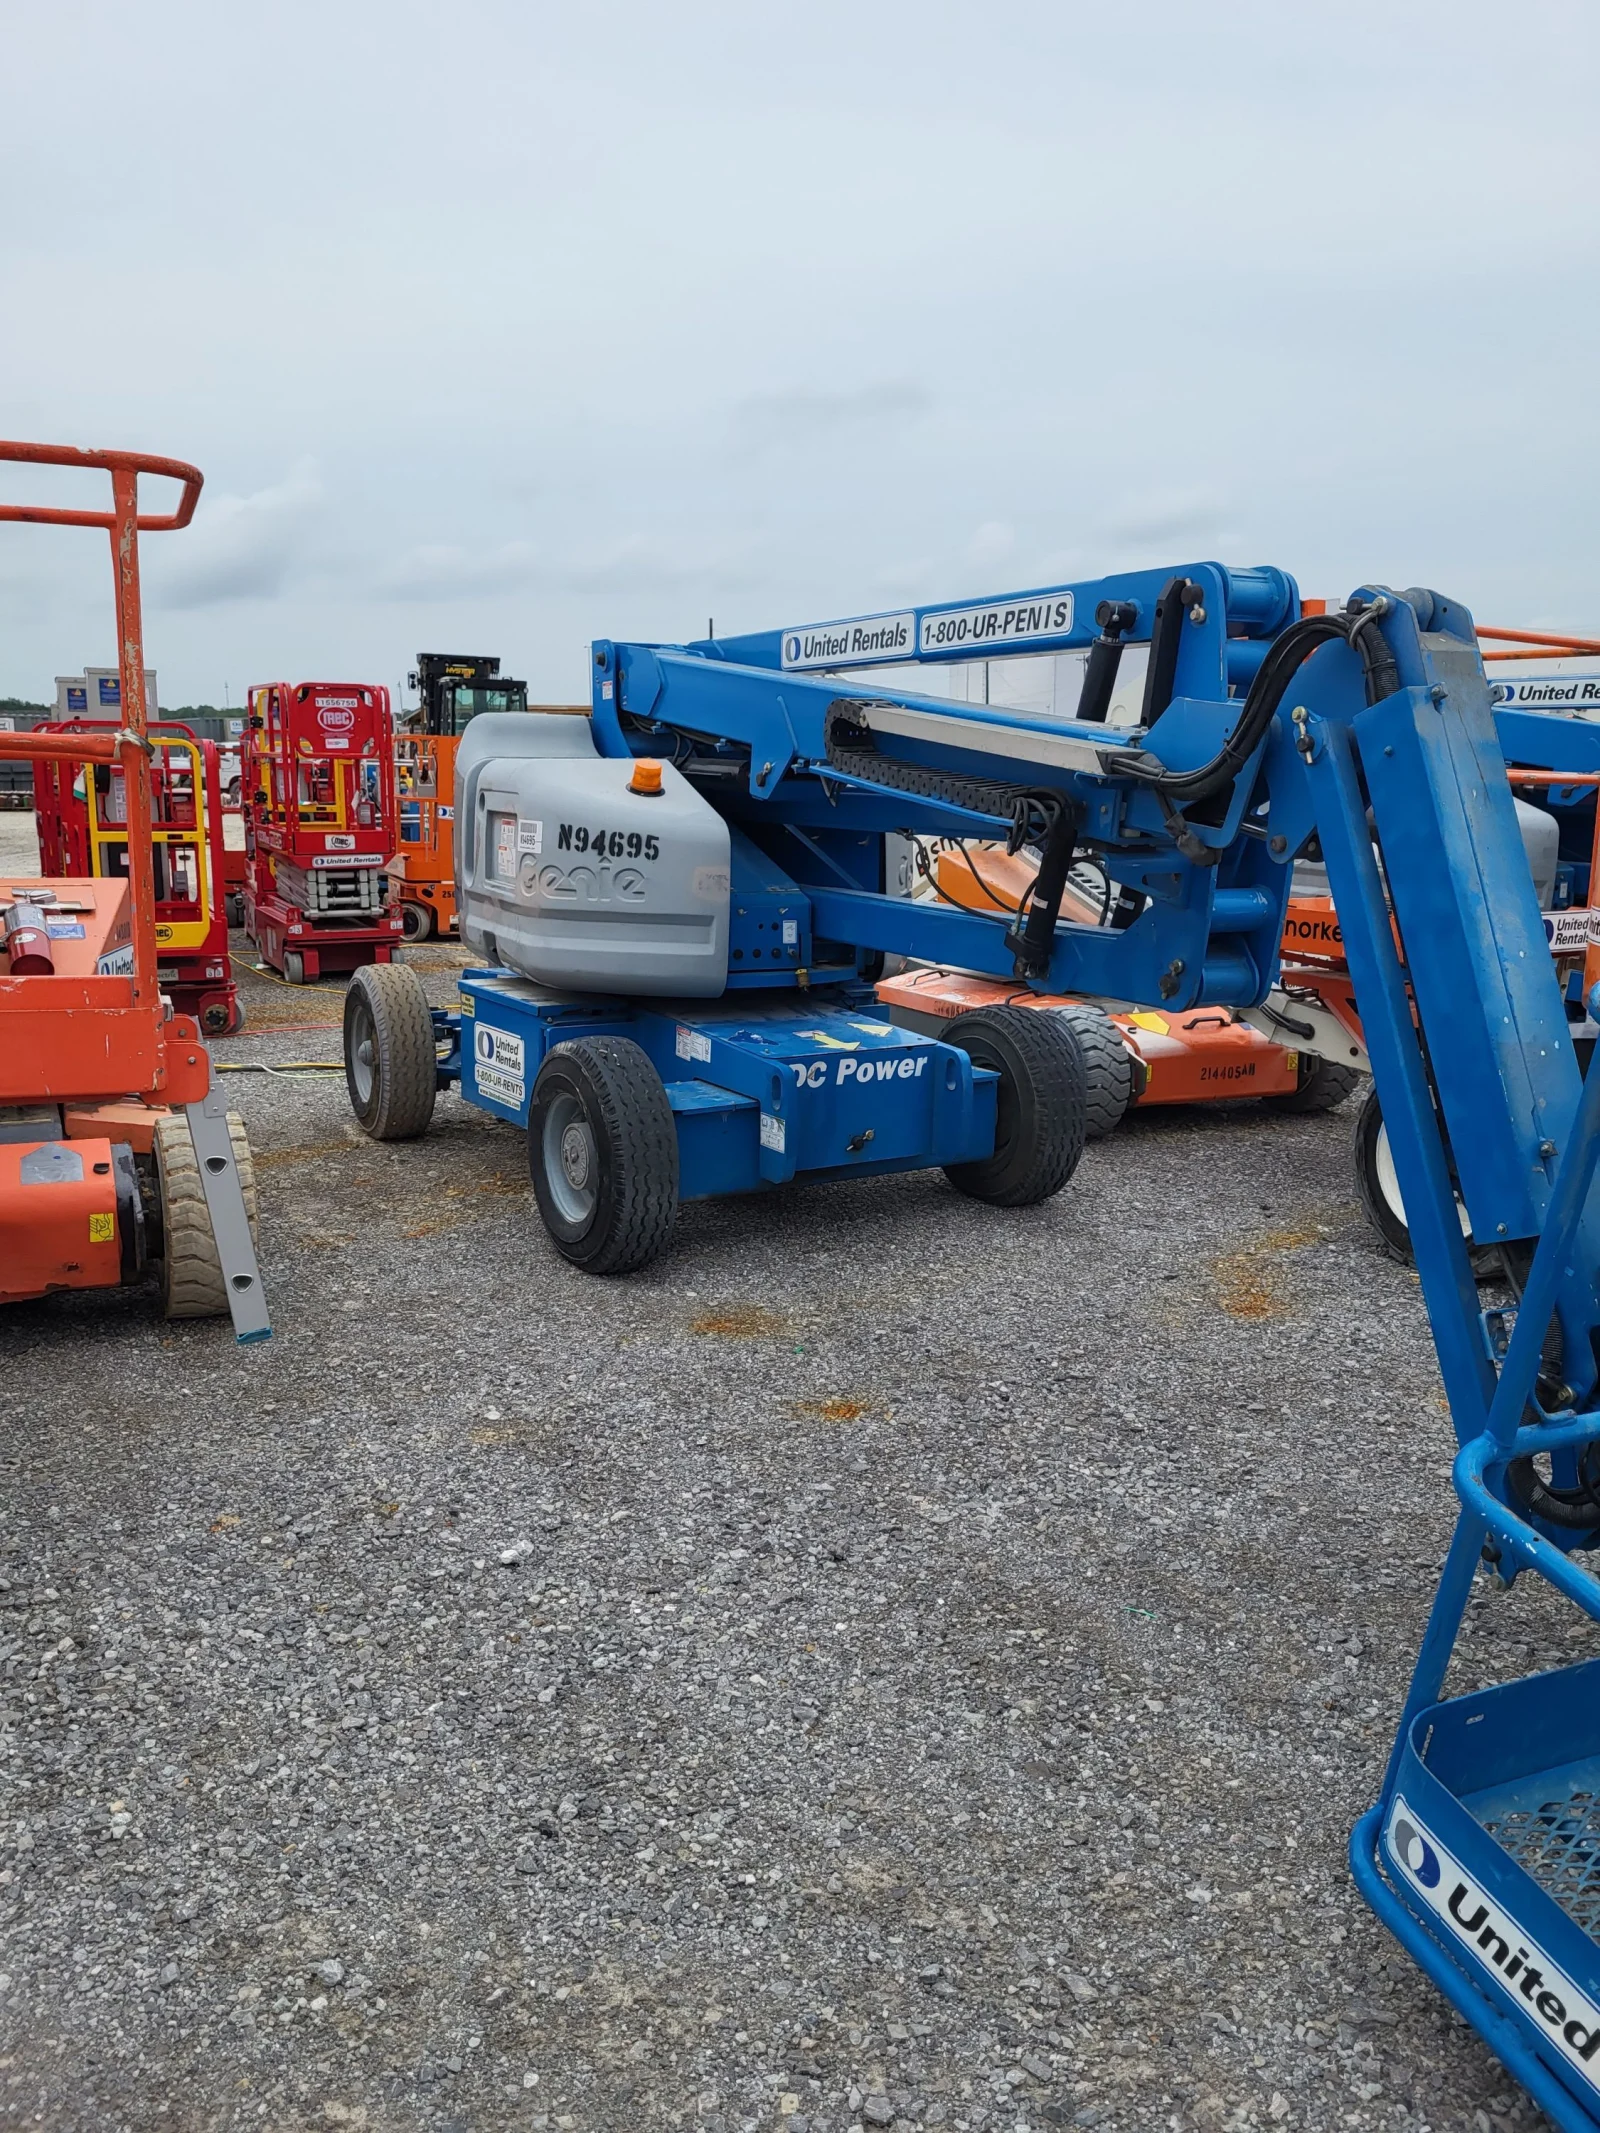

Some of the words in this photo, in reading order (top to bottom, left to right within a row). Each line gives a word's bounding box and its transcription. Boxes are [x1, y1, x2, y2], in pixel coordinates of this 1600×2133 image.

[924, 601, 1068, 645] 1-800-UR-PENIS
[803, 629, 849, 659] United
[851, 622, 907, 651] Rentals
[1519, 684, 1579, 701] United
[558, 824, 660, 861] N94695
[353, 856, 381, 864] Rentals
[1284, 919, 1344, 943] norke
[1557, 917, 1590, 931] United
[111, 952, 134, 975] United
[495, 1036, 519, 1055] United
[495, 1051, 522, 1071] Rentals
[836, 1056, 928, 1085] Power
[476, 1069, 523, 1097] 1-800-UR-RENTS
[1447, 1882, 1600, 2063] United
